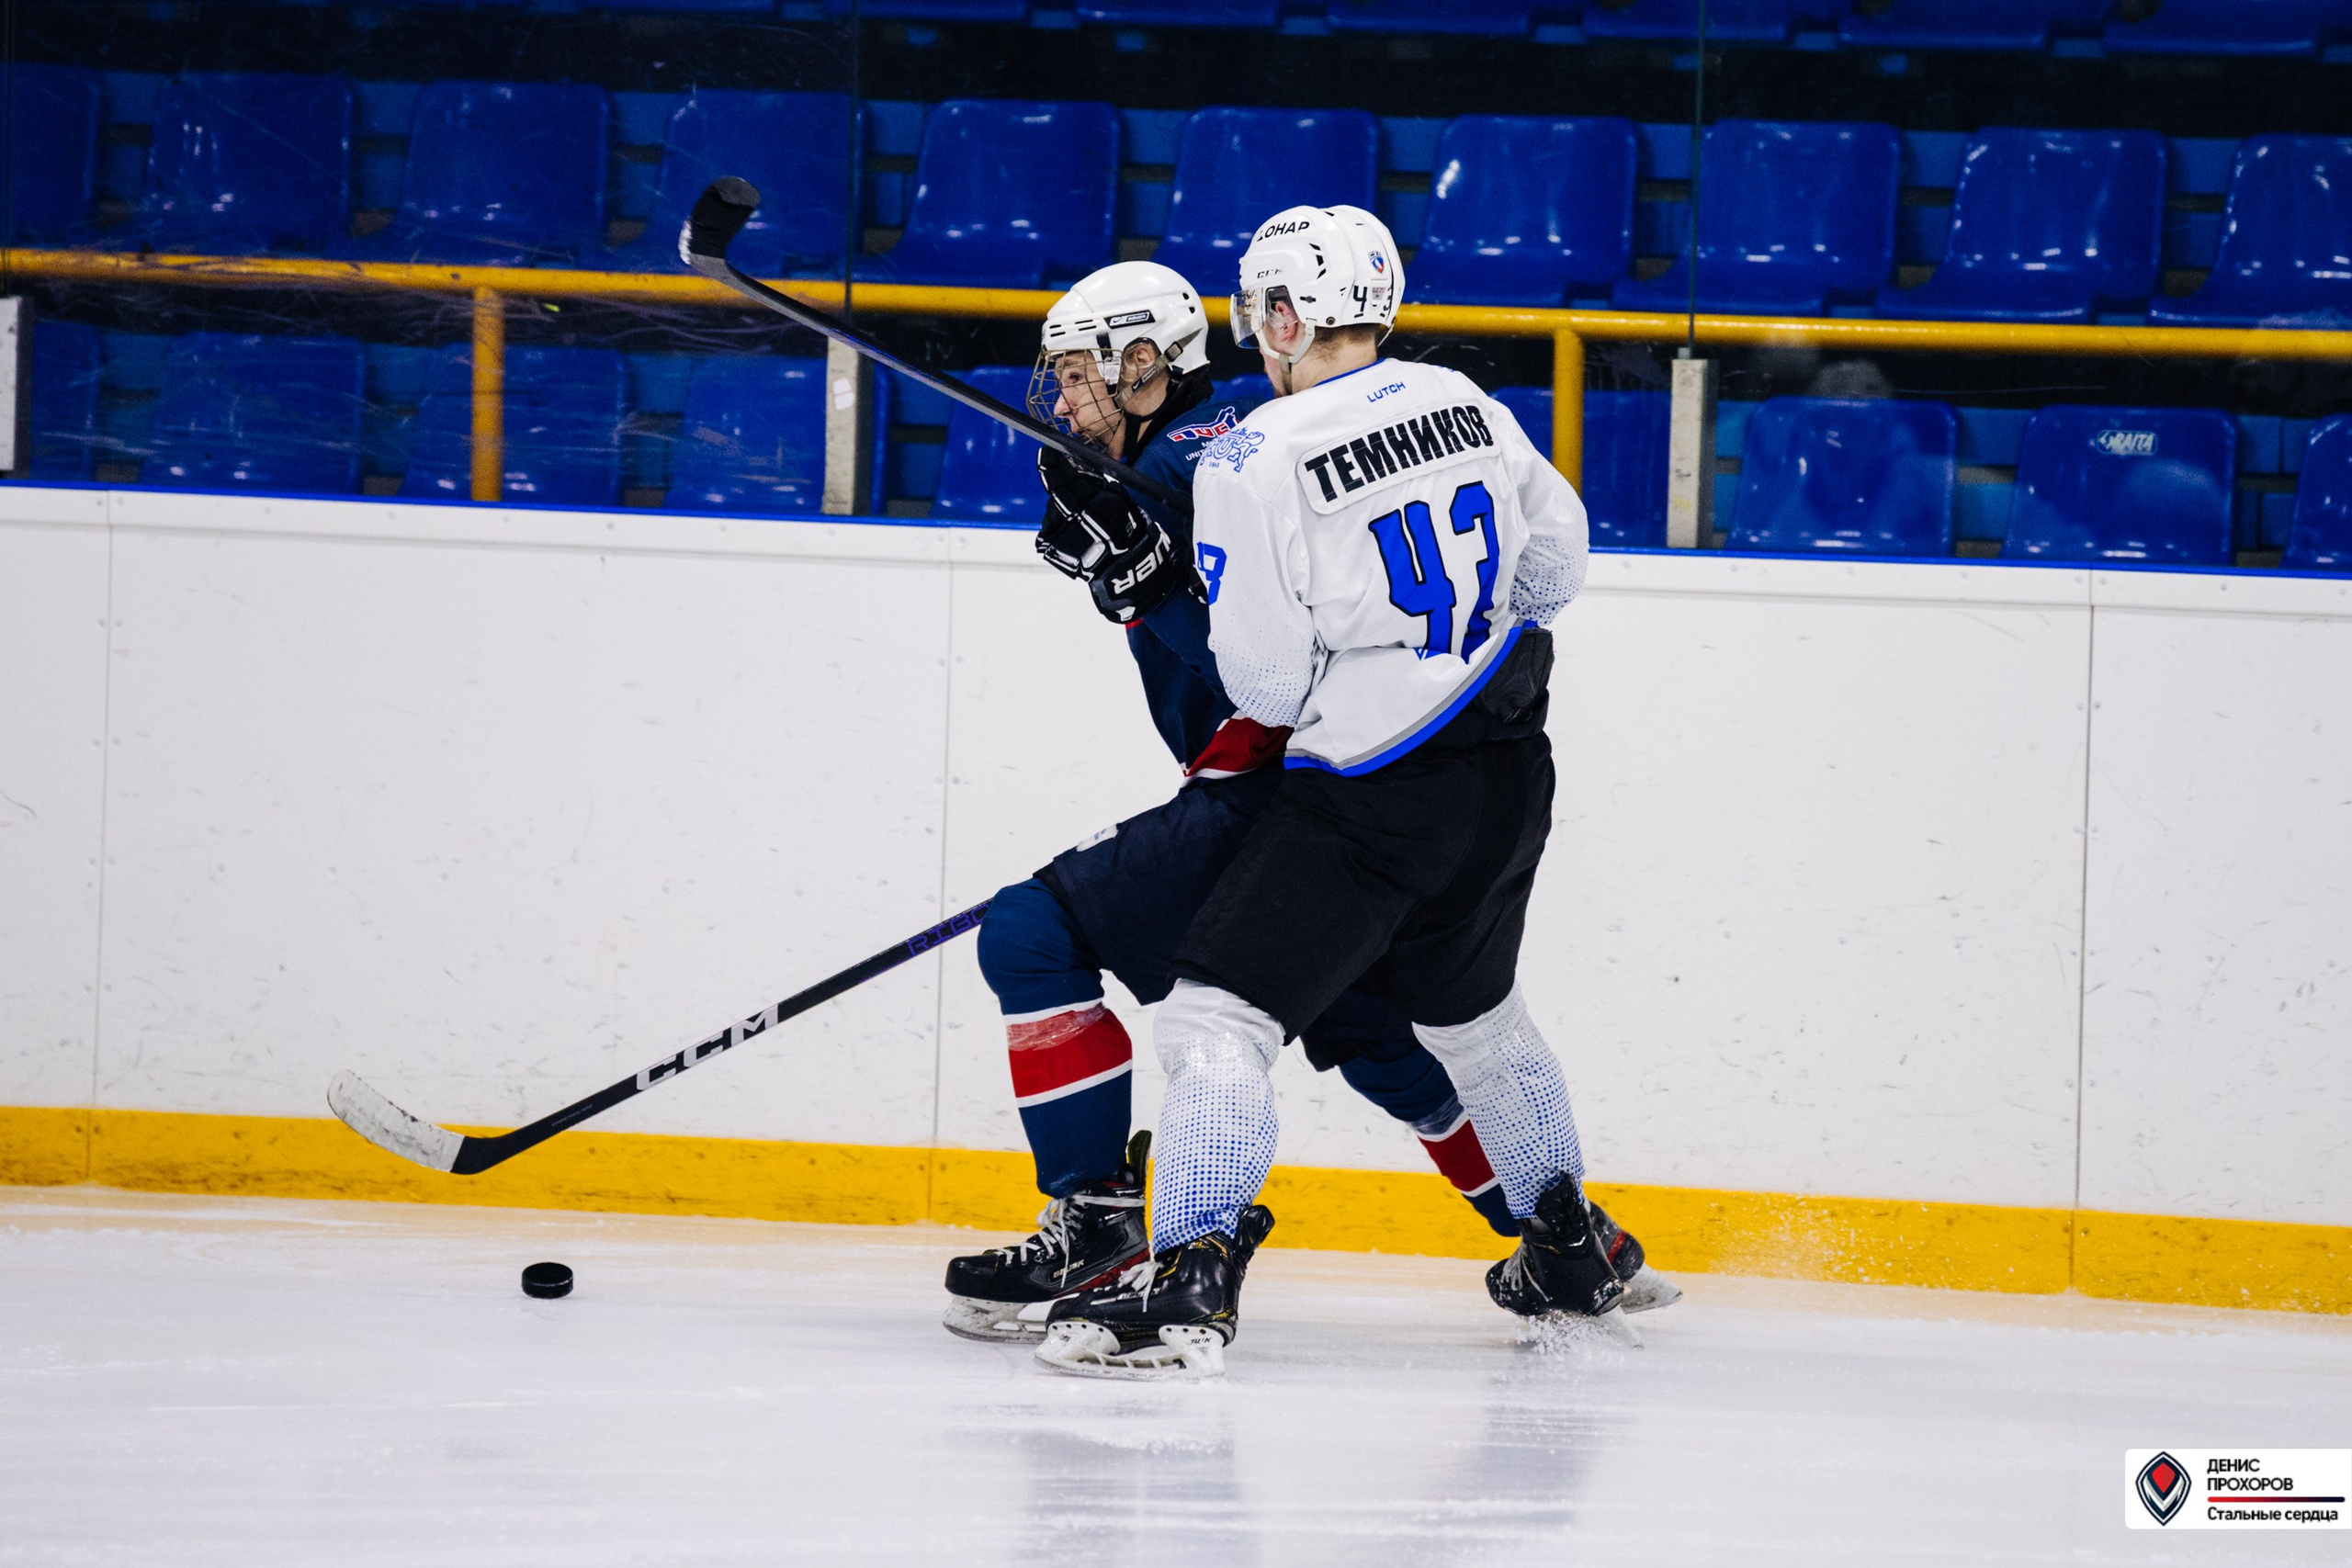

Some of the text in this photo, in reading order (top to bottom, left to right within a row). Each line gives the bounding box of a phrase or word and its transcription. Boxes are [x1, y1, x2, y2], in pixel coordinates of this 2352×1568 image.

[1366, 381, 1407, 403] LUTCH
[1304, 405, 1495, 503] ТЕМНИКОВ
[636, 1003, 779, 1091] CCM
